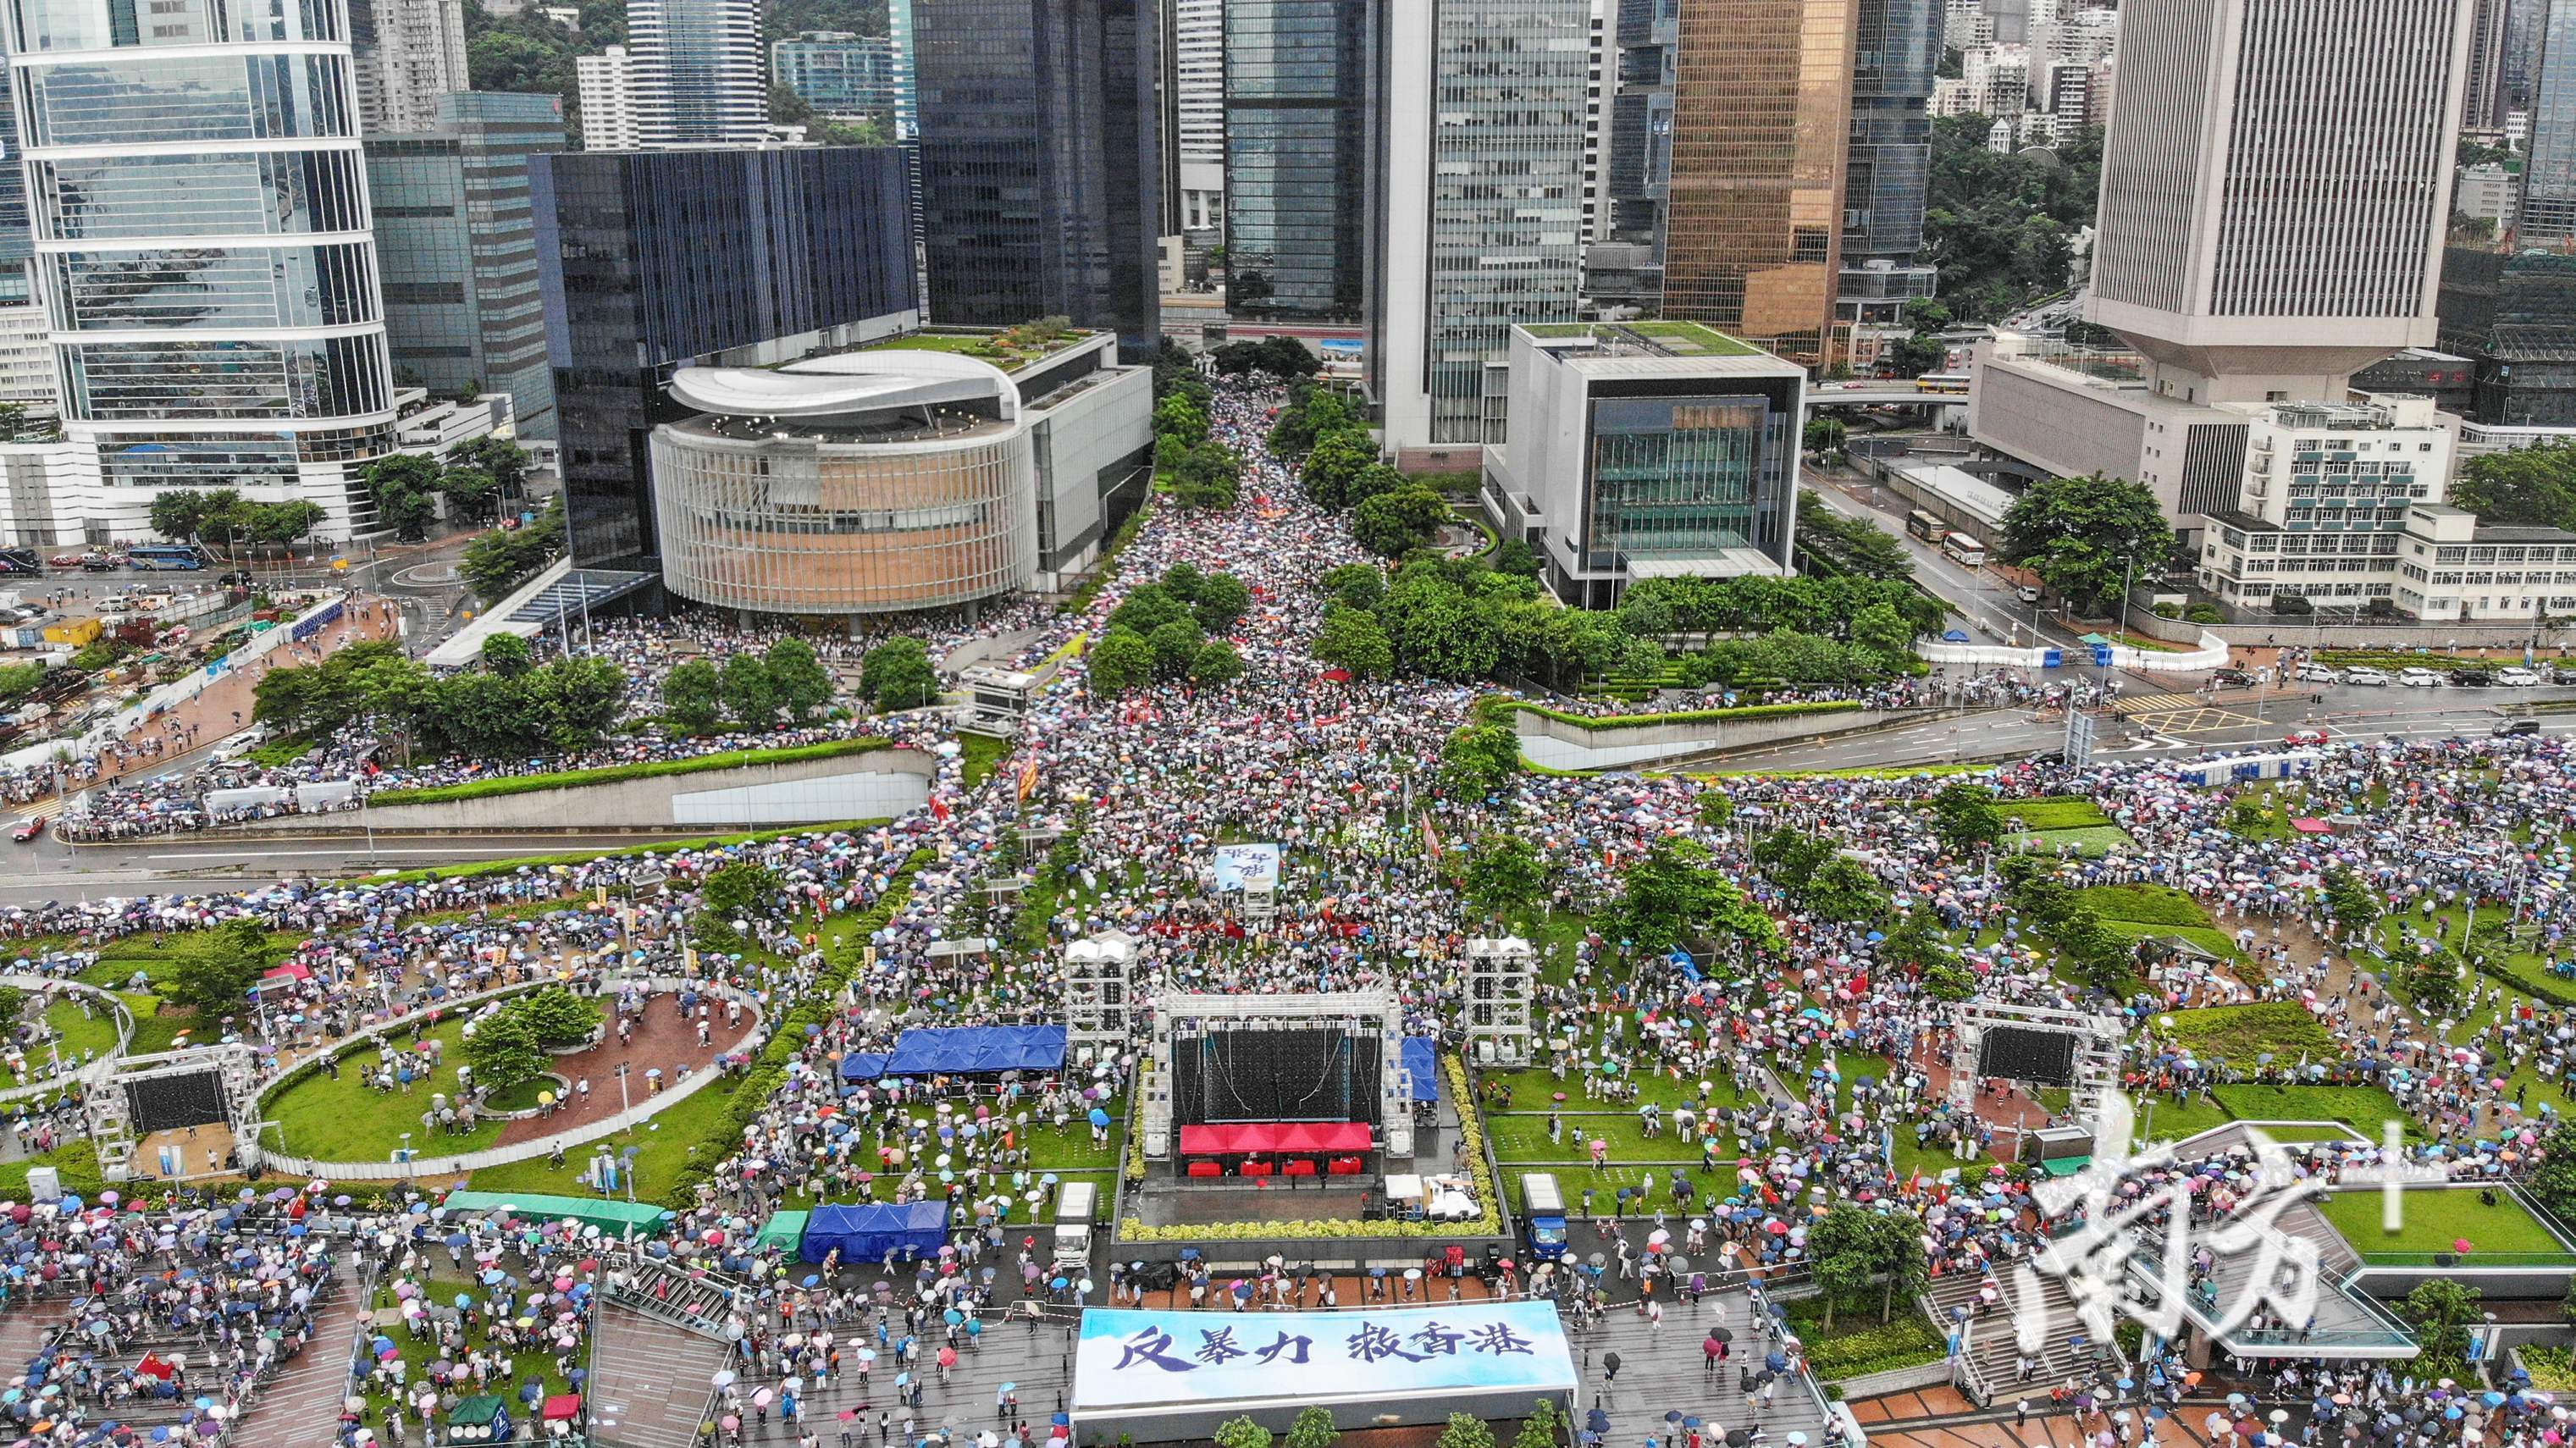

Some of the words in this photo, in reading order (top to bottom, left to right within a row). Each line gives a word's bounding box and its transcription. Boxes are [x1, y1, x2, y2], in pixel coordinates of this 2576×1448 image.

[1113, 1324, 1313, 1373] 反暴力
[1346, 1321, 1534, 1364] 救香港
